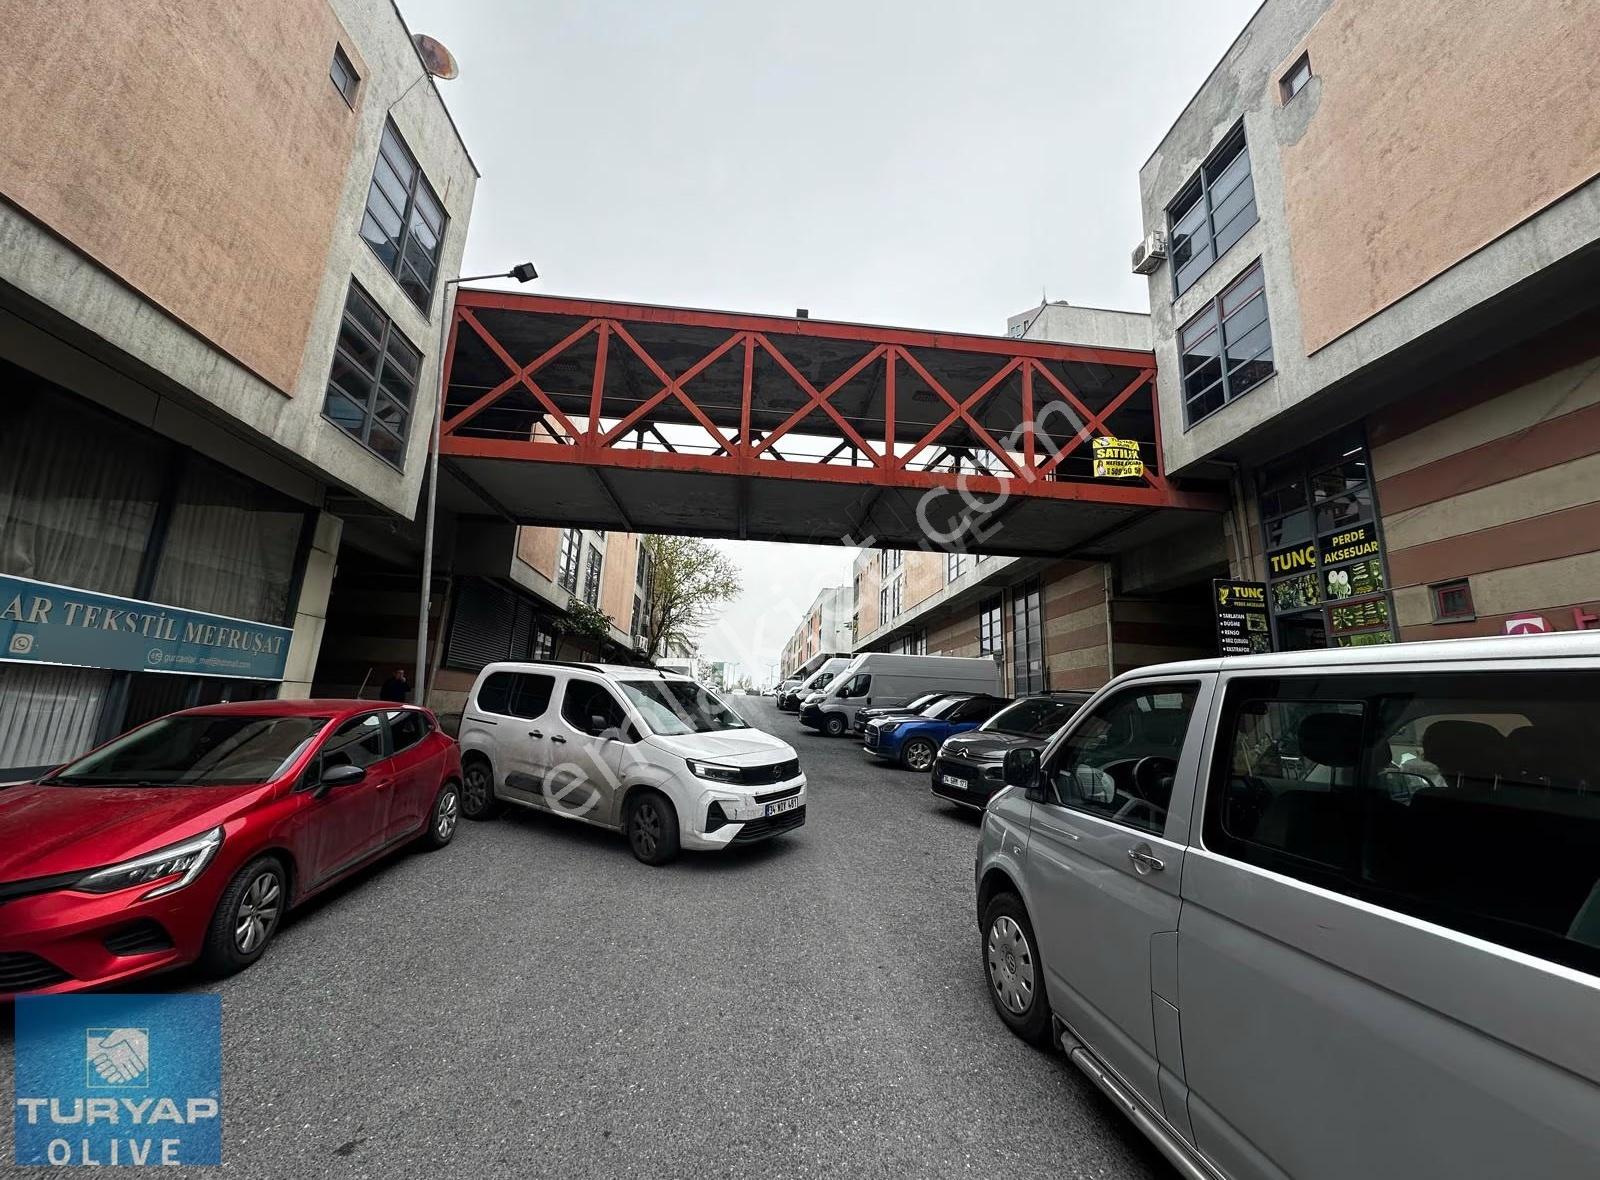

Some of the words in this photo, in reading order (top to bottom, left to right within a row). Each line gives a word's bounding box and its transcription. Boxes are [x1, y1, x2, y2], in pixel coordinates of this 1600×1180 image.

[1332, 529, 1366, 547] PERDE
[1270, 545, 1316, 573] TUNÇ
[1323, 541, 1379, 565] AKSESUAR
[1232, 586, 1265, 602] TUNÇ
[63, 600, 178, 642] TEKSTİL
[183, 621, 286, 656] MEFRUŞAT
